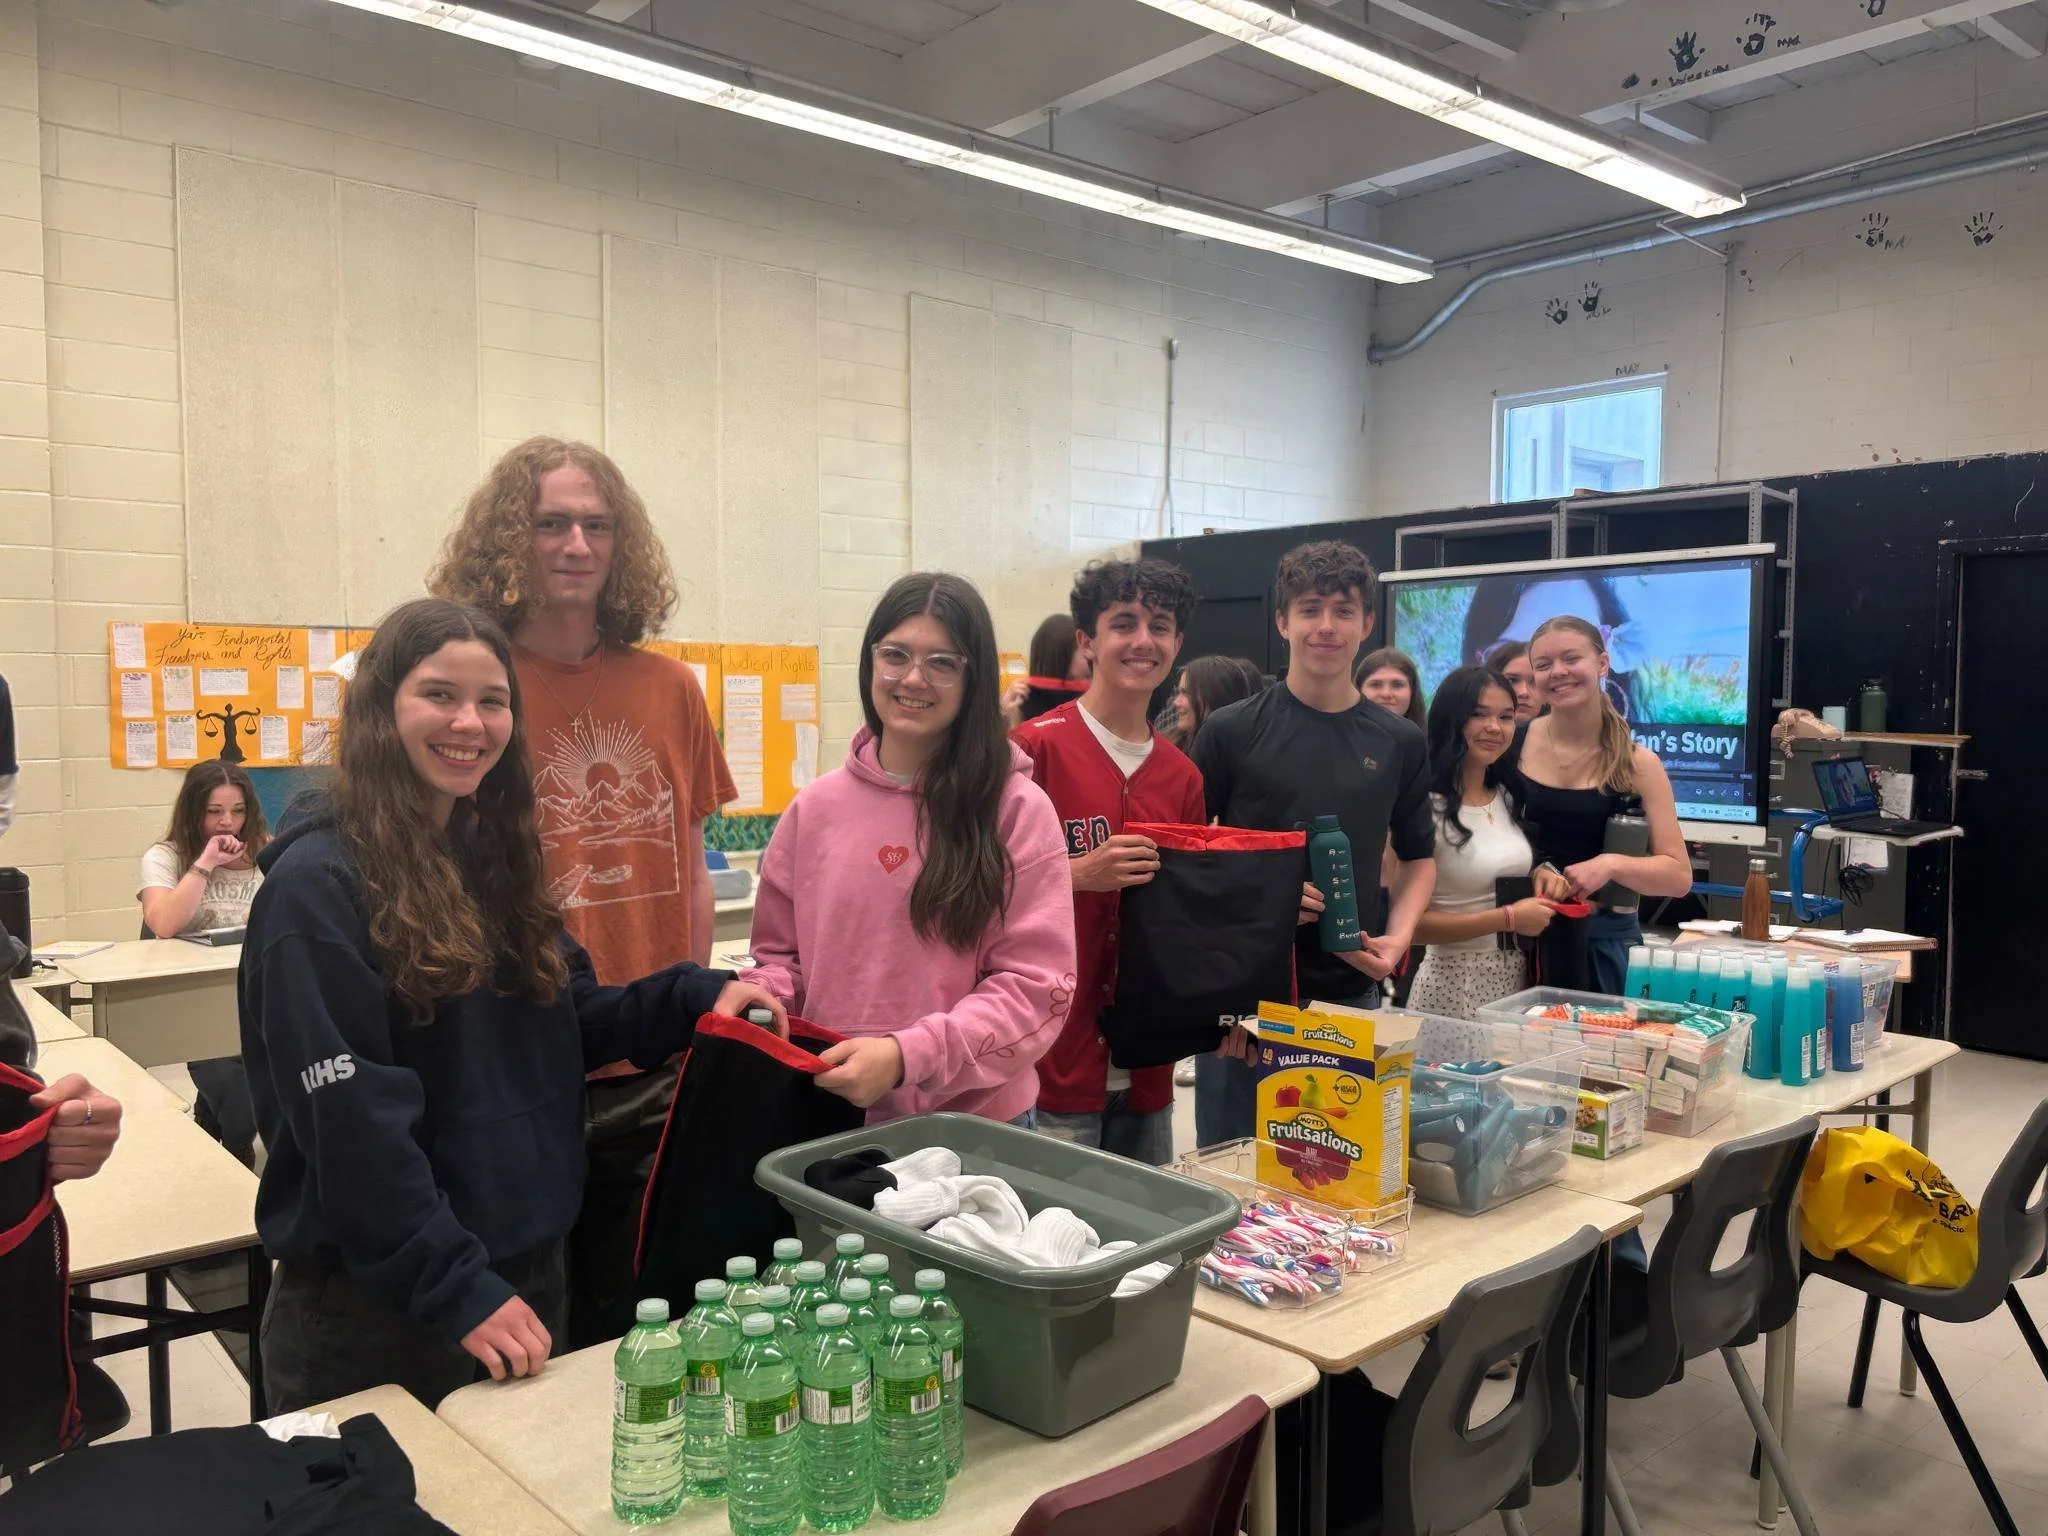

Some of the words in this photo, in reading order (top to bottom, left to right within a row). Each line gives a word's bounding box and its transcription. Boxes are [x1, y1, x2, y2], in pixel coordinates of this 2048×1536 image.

[221, 647, 242, 659] and
[781, 649, 815, 683] Rights
[1681, 731, 1738, 760] Story
[1303, 1030, 1354, 1048] Fruitsations
[1278, 1054, 1310, 1066] VALUE
[1312, 1055, 1340, 1066] PACK
[1269, 1123, 1360, 1158] Fruitsations
